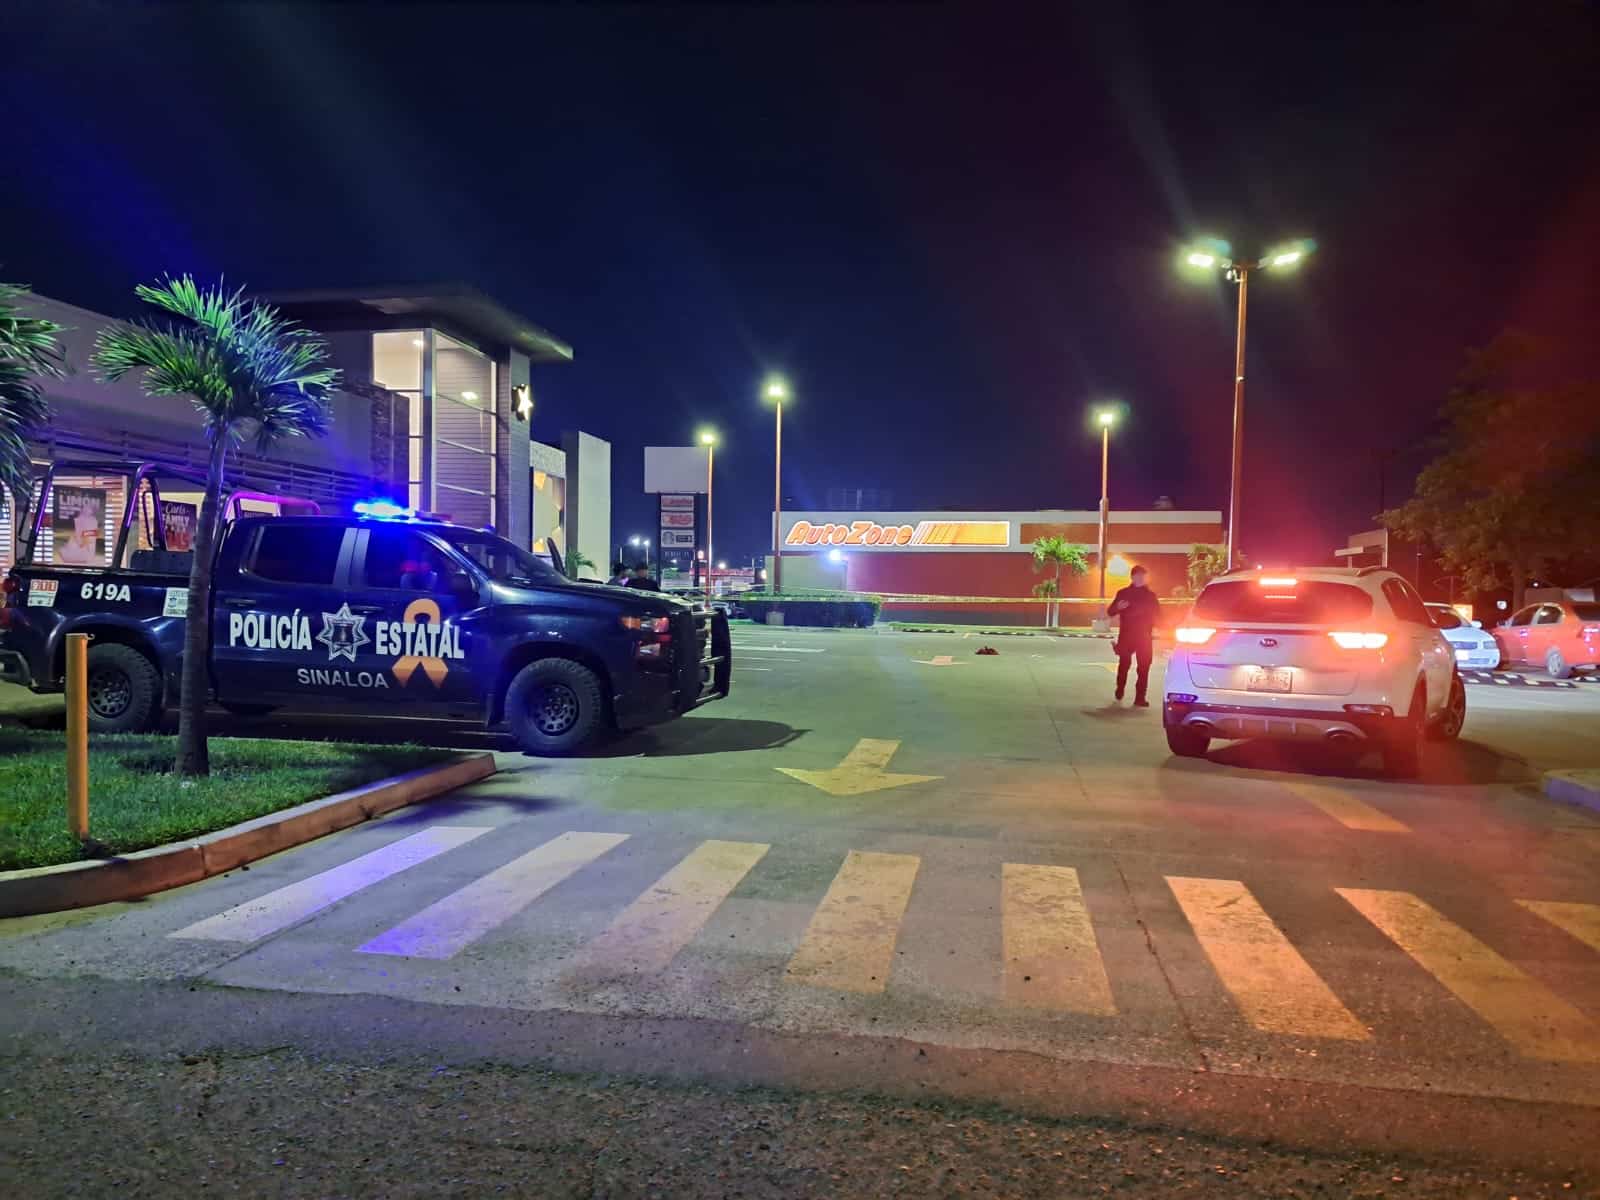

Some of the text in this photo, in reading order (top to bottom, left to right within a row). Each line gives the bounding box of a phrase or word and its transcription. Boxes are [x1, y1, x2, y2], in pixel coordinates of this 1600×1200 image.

[786, 521, 915, 546] AutoZone
[31, 581, 56, 592] 911
[81, 582, 132, 602] 619A
[229, 608, 465, 659] POLICÍA ESTATAL
[297, 668, 390, 689] SINALOA
